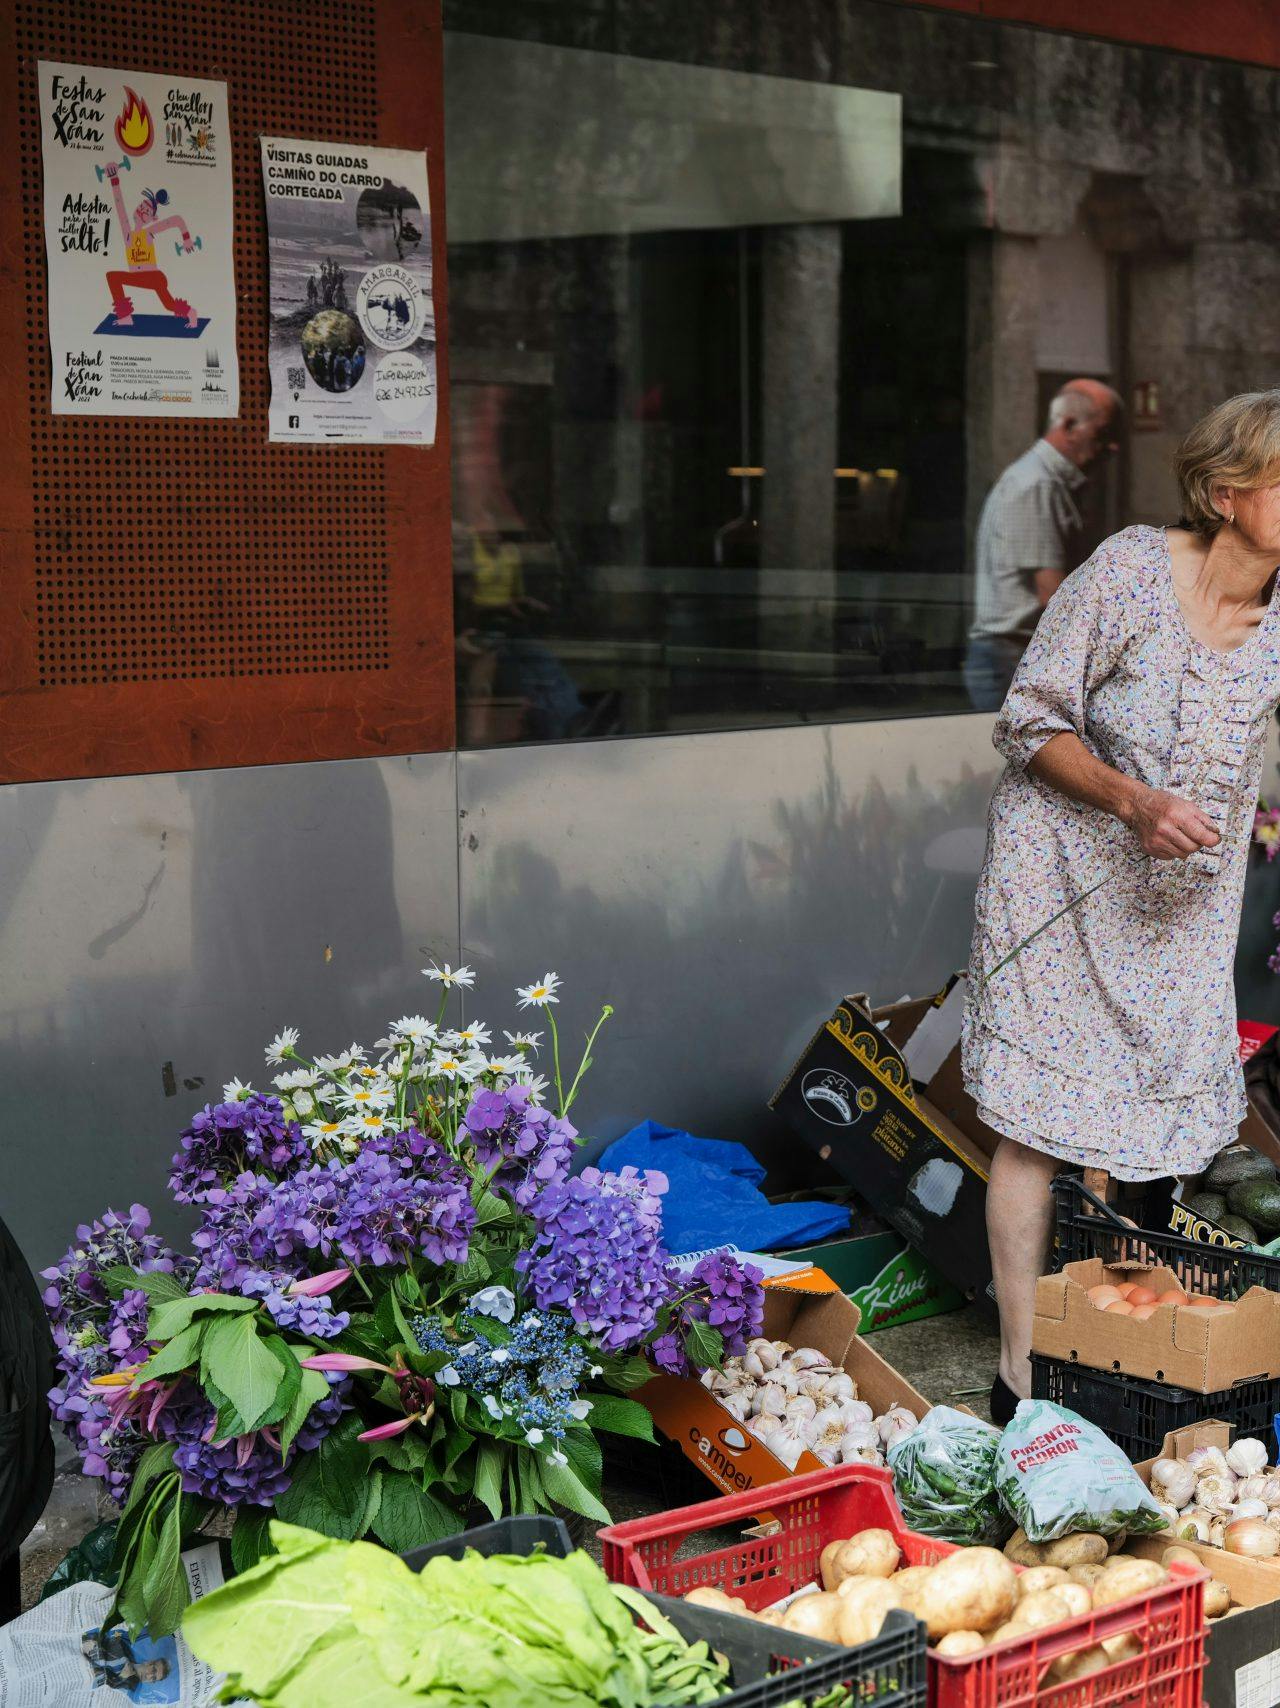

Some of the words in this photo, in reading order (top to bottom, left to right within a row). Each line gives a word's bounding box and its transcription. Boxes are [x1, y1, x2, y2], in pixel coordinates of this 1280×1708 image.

[52, 75, 106, 103] Festas
[56, 100, 68, 114] de
[69, 101, 105, 123] San
[52, 112, 105, 148] Xoán
[267, 150, 312, 164] VISITAS
[316, 155, 369, 170] GUIADAS
[268, 166, 316, 181] CAMIÑO
[319, 171, 337, 183] DO
[341, 174, 382, 188] CARRO
[269, 184, 343, 200] CORTEGADA
[62, 193, 112, 215] Adestra
[66, 350, 104, 367] Festival
[68, 368, 78, 379] de
[78, 368, 103, 385] San
[64, 376, 103, 402] Xoán
[1167, 1204, 1247, 1249] PICO
[862, 1270, 928, 1318] Kiwi
[689, 1426, 756, 1491] campel
[190, 1561, 199, 1574] El
